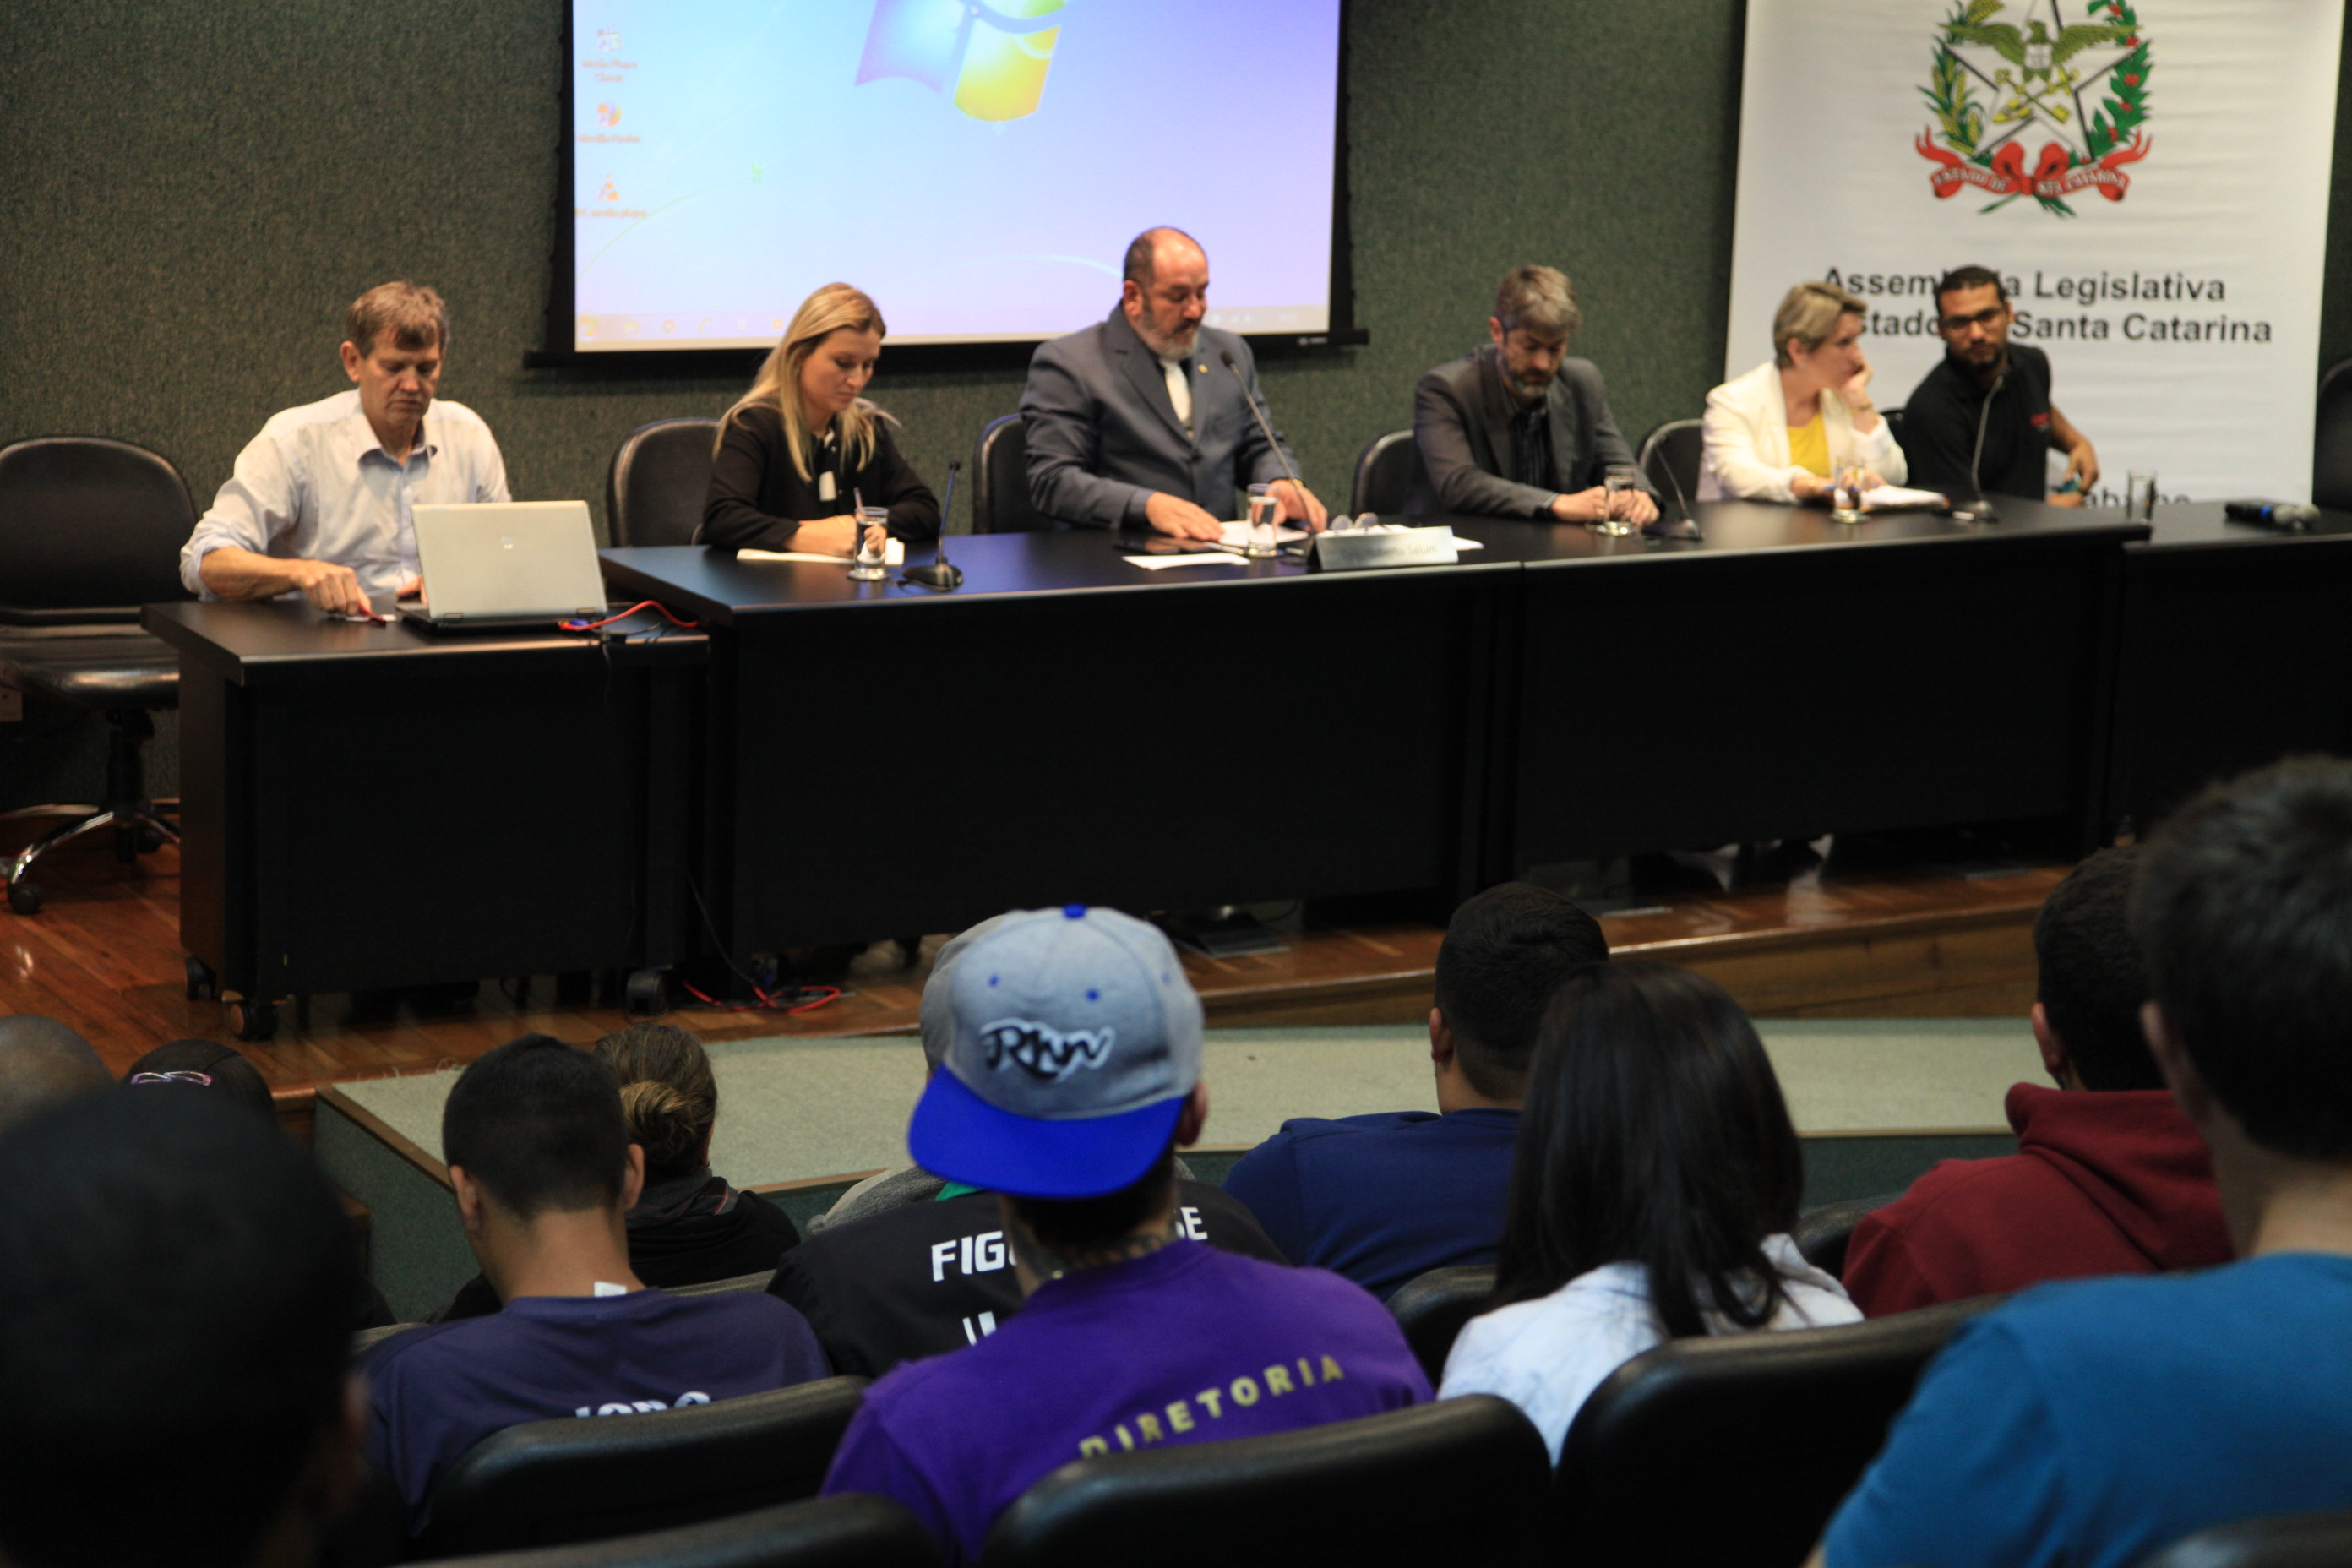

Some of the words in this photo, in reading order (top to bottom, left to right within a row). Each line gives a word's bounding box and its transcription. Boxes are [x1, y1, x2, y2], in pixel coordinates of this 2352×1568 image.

[2034, 270, 2226, 306] Legislativa
[2012, 310, 2110, 339] Santa
[2123, 312, 2273, 343] Catarina
